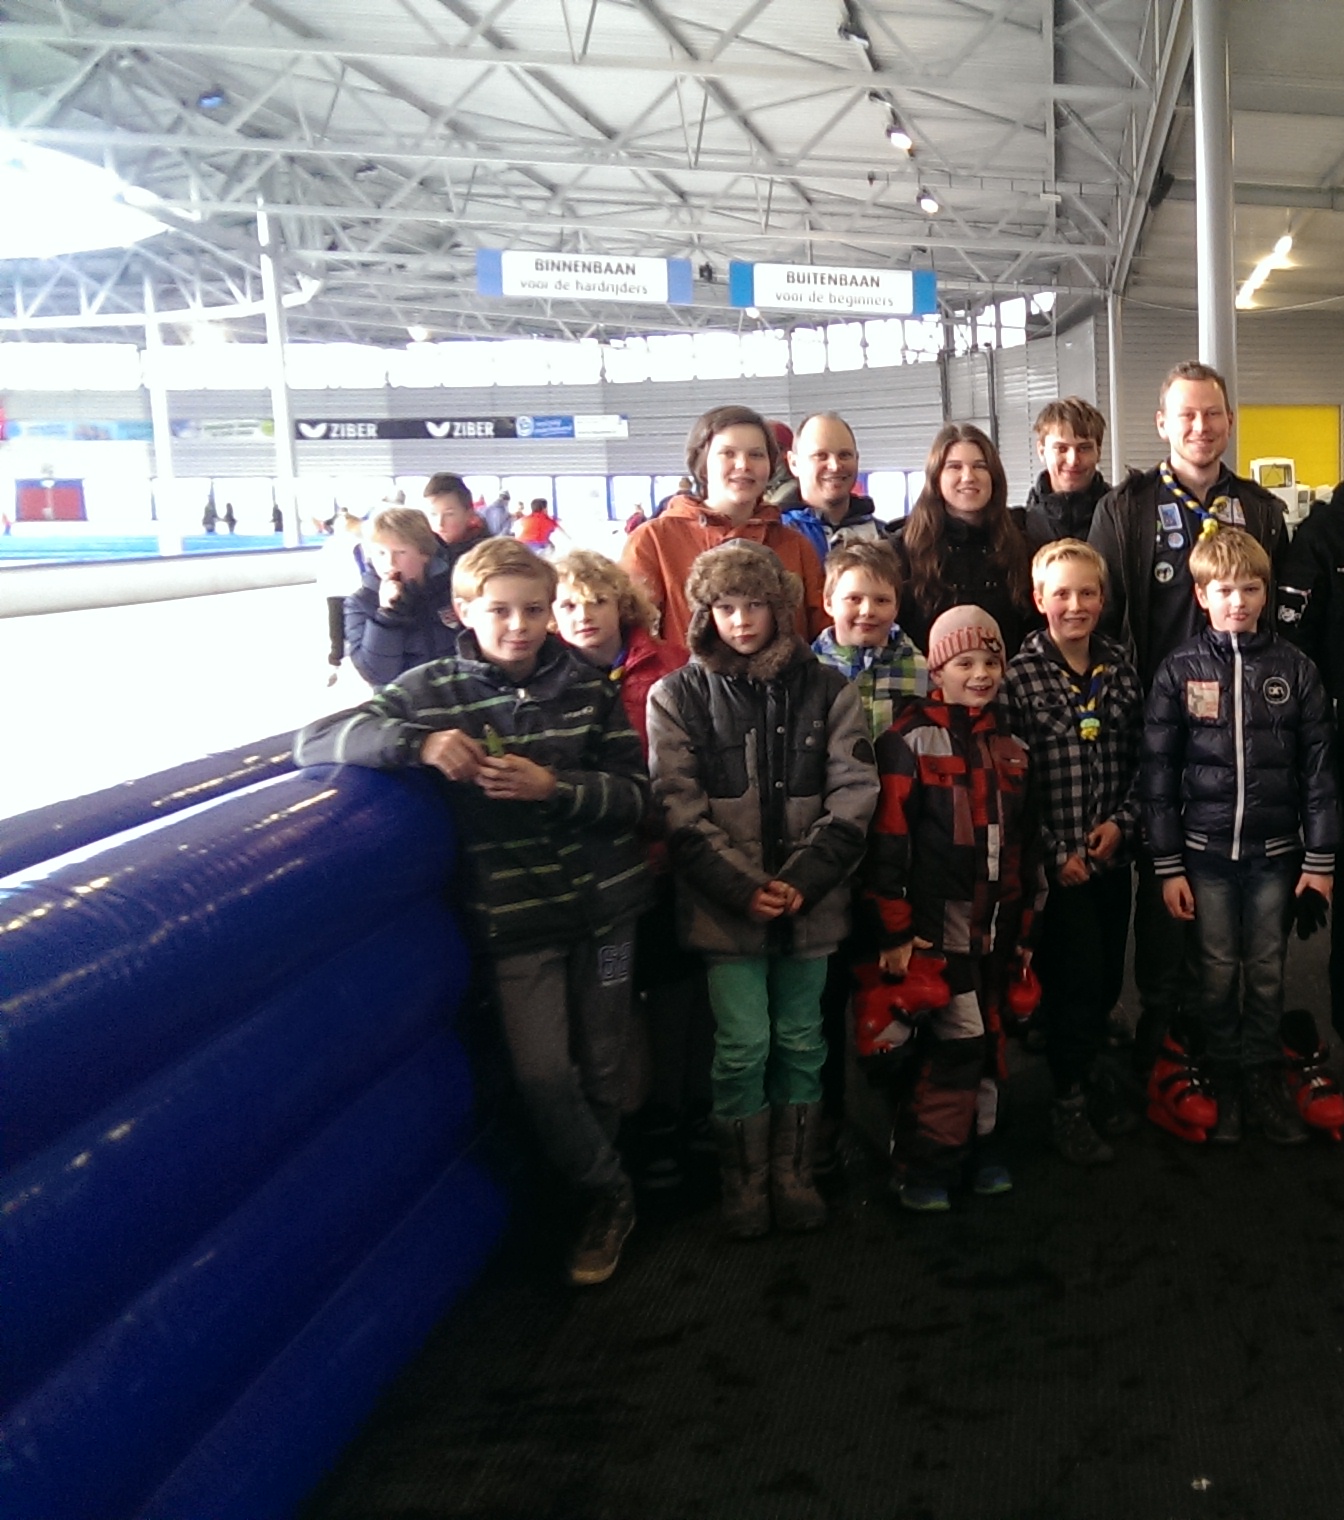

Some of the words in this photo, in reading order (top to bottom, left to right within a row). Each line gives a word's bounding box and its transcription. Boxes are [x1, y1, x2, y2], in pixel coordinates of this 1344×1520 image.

[534, 257, 637, 276] BINNENBAAN
[520, 279, 549, 290] voor
[554, 279, 571, 291] de
[575, 279, 649, 296] hardrijders
[786, 270, 881, 288] BUITENBAAN
[775, 291, 803, 302] voor
[808, 290, 824, 304] de
[828, 291, 894, 308] beginners
[329, 421, 379, 438] ZIBER
[451, 420, 496, 437] ZIBER
